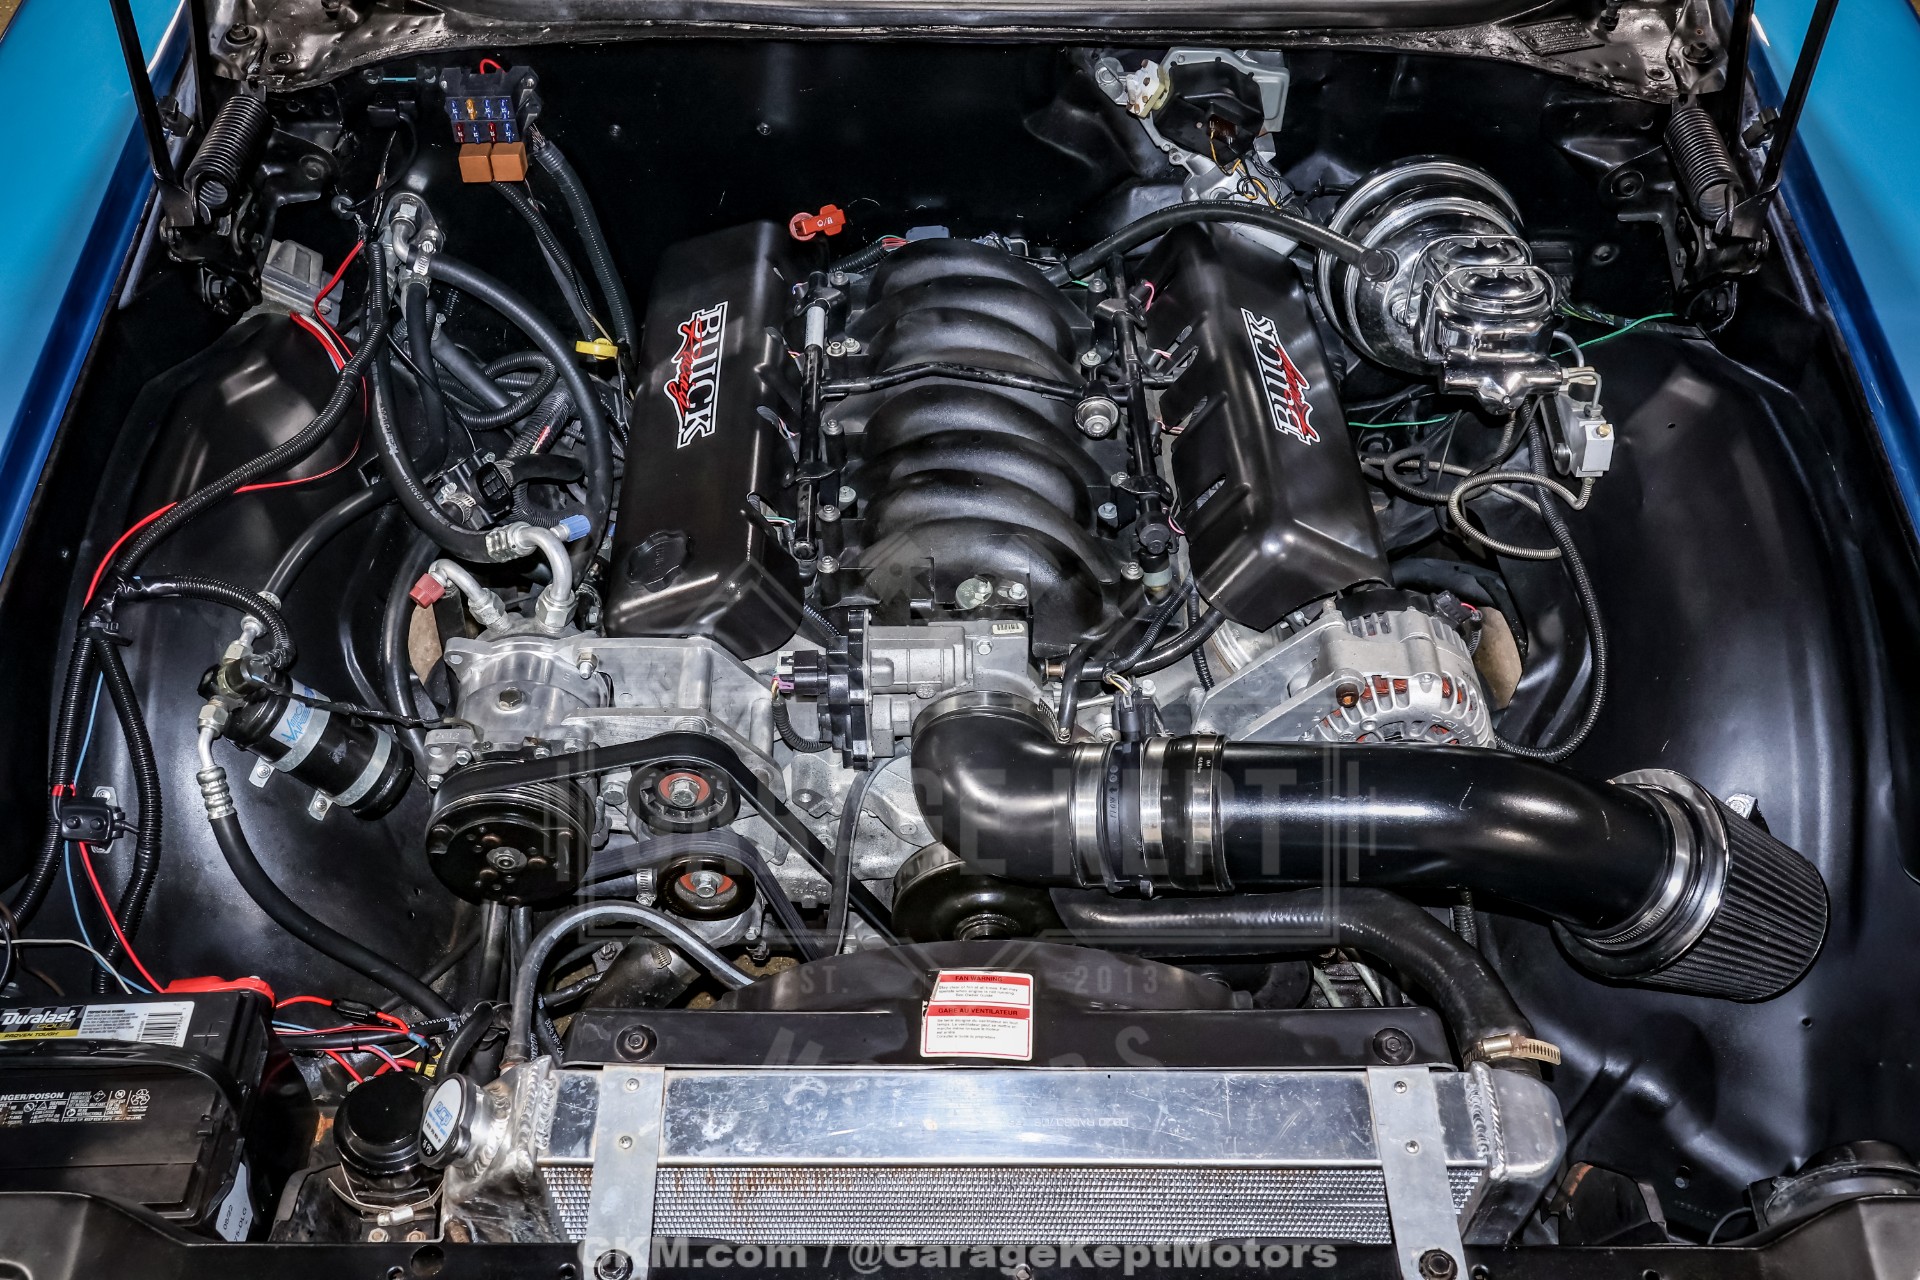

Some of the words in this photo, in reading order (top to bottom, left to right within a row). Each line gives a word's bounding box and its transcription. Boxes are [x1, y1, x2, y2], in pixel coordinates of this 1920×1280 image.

[681, 304, 724, 443] BUICK
[1246, 311, 1306, 440] BUICK
[970, 975, 1003, 983] WARNING
[1, 1009, 77, 1027] Duralast
[971, 1008, 1018, 1016] VENTILATEUR
[36, 1022, 70, 1030] GOLD
